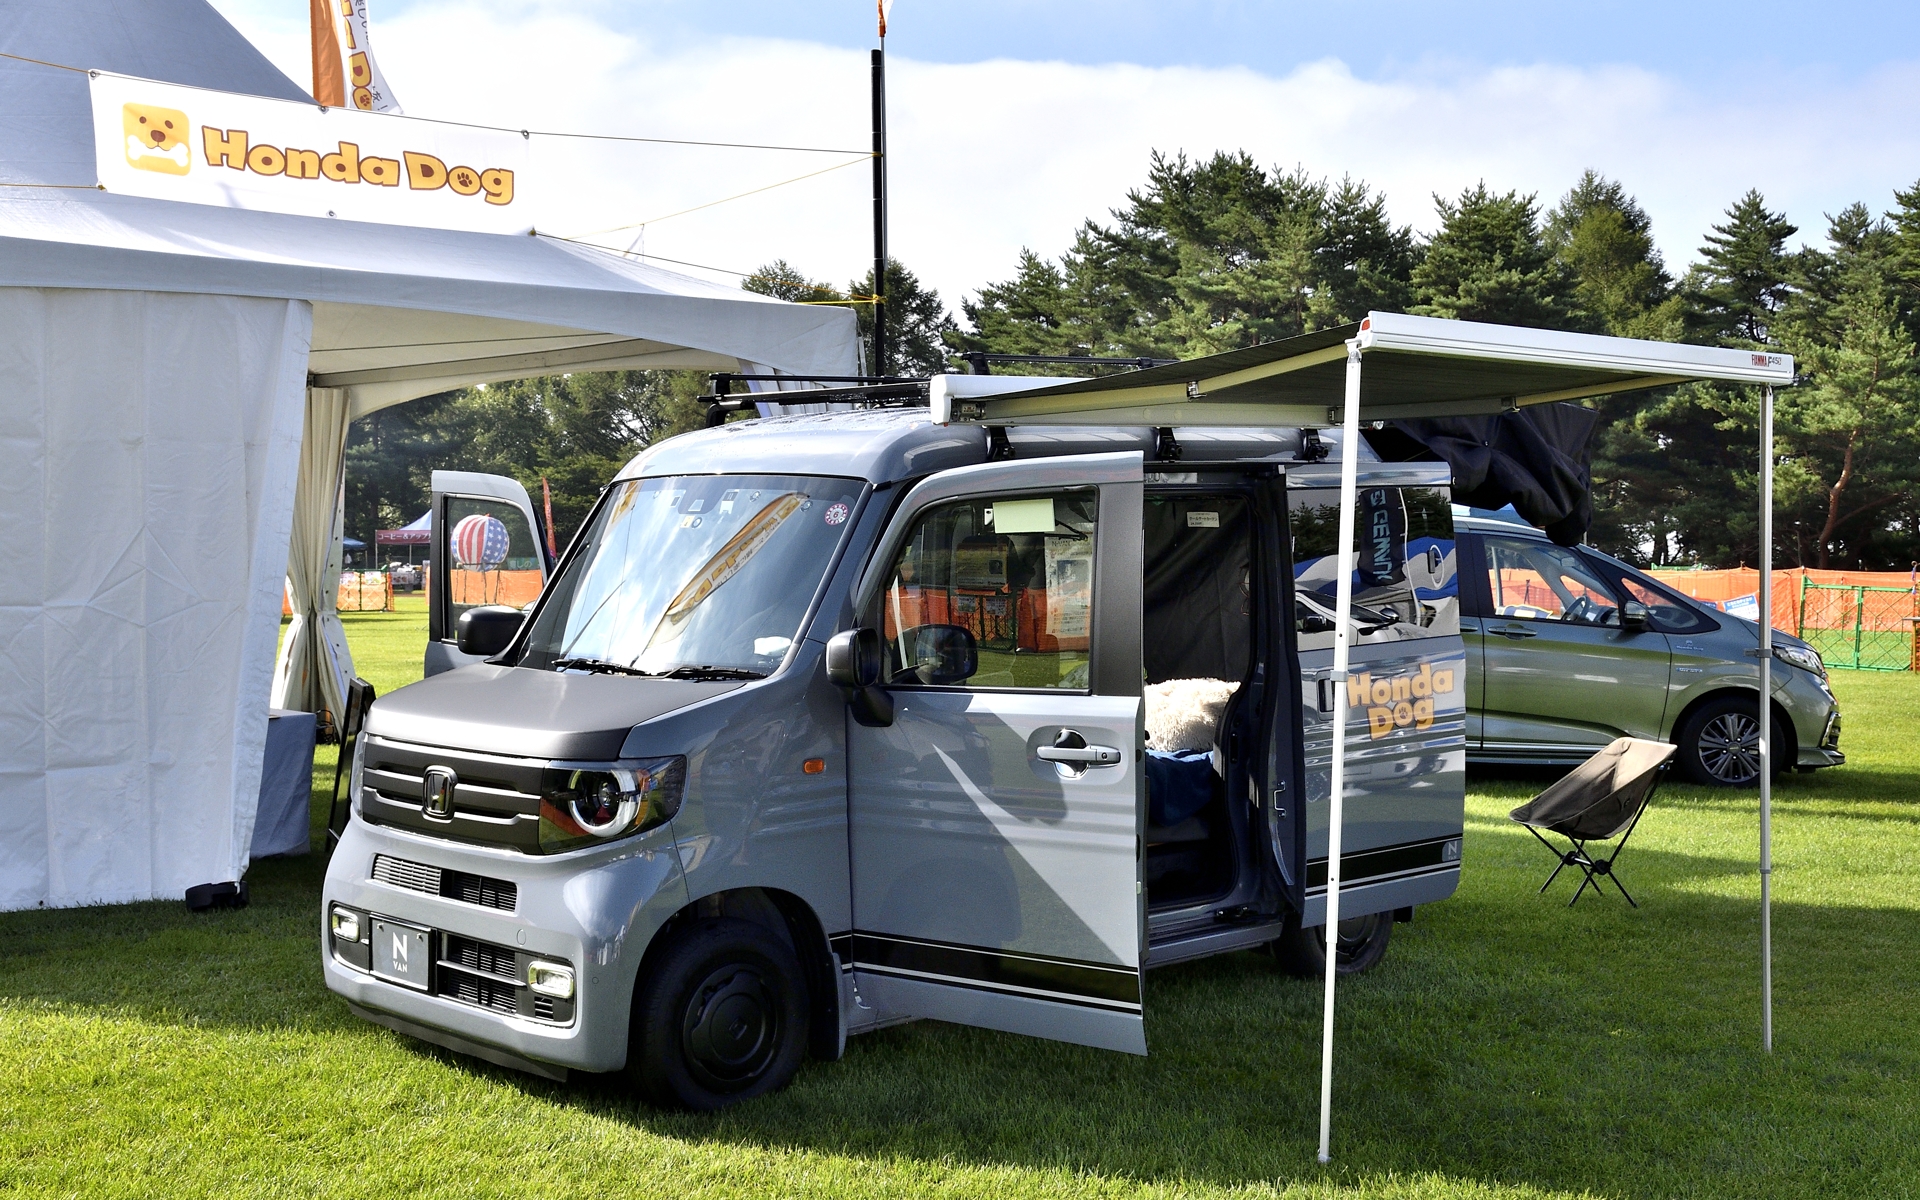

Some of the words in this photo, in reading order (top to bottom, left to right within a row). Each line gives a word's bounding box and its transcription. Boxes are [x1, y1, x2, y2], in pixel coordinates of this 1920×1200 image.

[201, 125, 400, 187] Honda
[403, 150, 514, 206] Dog
[1346, 662, 1454, 709] Honda
[1366, 697, 1434, 741] Dog
[392, 931, 408, 963] N
[392, 960, 408, 973] VAN
